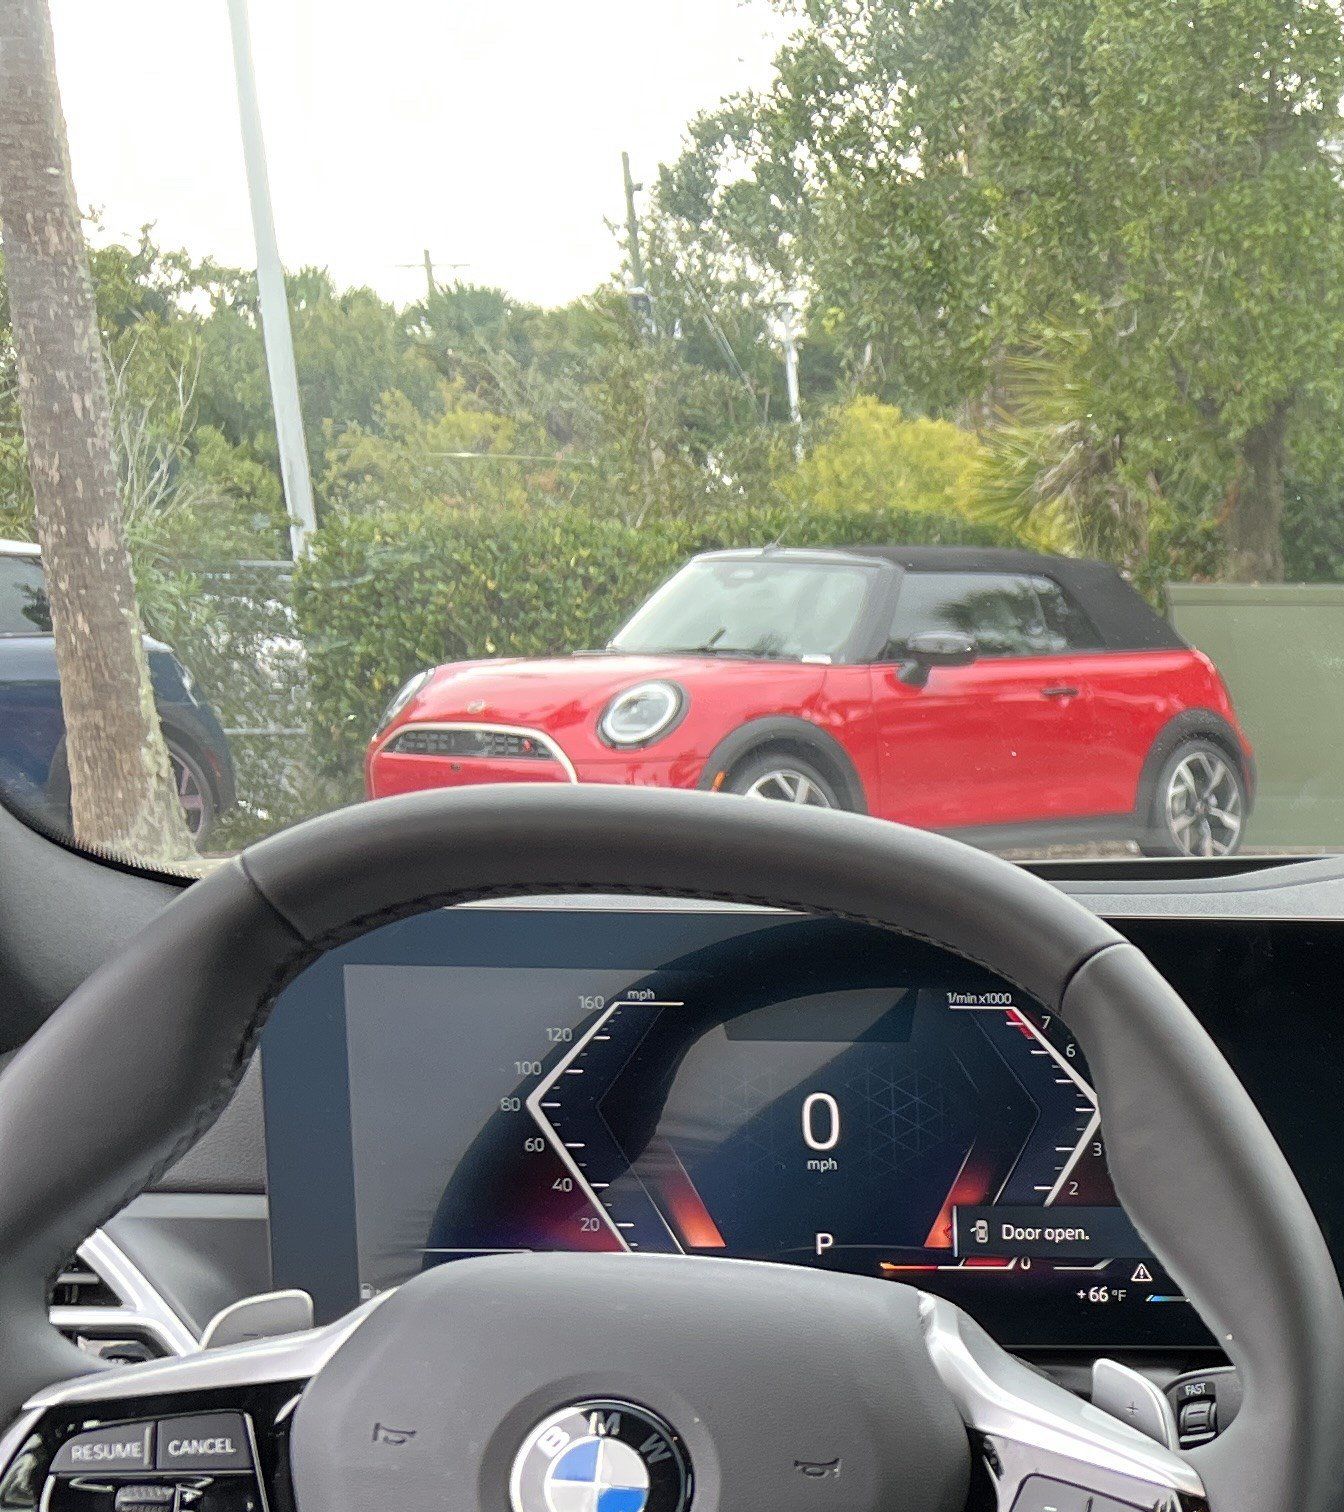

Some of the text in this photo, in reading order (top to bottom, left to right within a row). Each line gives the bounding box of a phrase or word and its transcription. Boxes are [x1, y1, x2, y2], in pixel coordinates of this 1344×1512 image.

[578, 995, 604, 1009] 160
[627, 989, 655, 1003] mph
[1041, 1015, 1051, 1030] 7
[546, 1028, 573, 1042] 120
[1066, 1043, 1076, 1058] 6
[514, 1061, 542, 1075] 100
[500, 1097, 521, 1112] 80
[801, 1092, 840, 1151] 0
[524, 1137, 545, 1153] 60
[1092, 1142, 1102, 1157] 3
[807, 1158, 838, 1172] mph
[552, 1177, 573, 1192] 40
[1068, 1181, 1079, 1196] 2
[580, 1217, 600, 1232] 20
[1002, 1224, 1090, 1243] Door open.
[815, 1233, 834, 1255] P
[1184, 1382, 1206, 1396] FAST
[536, 1410, 672, 1466] BMW
[71, 1441, 143, 1462] RESUME
[167, 1438, 237, 1457] CANCEL
